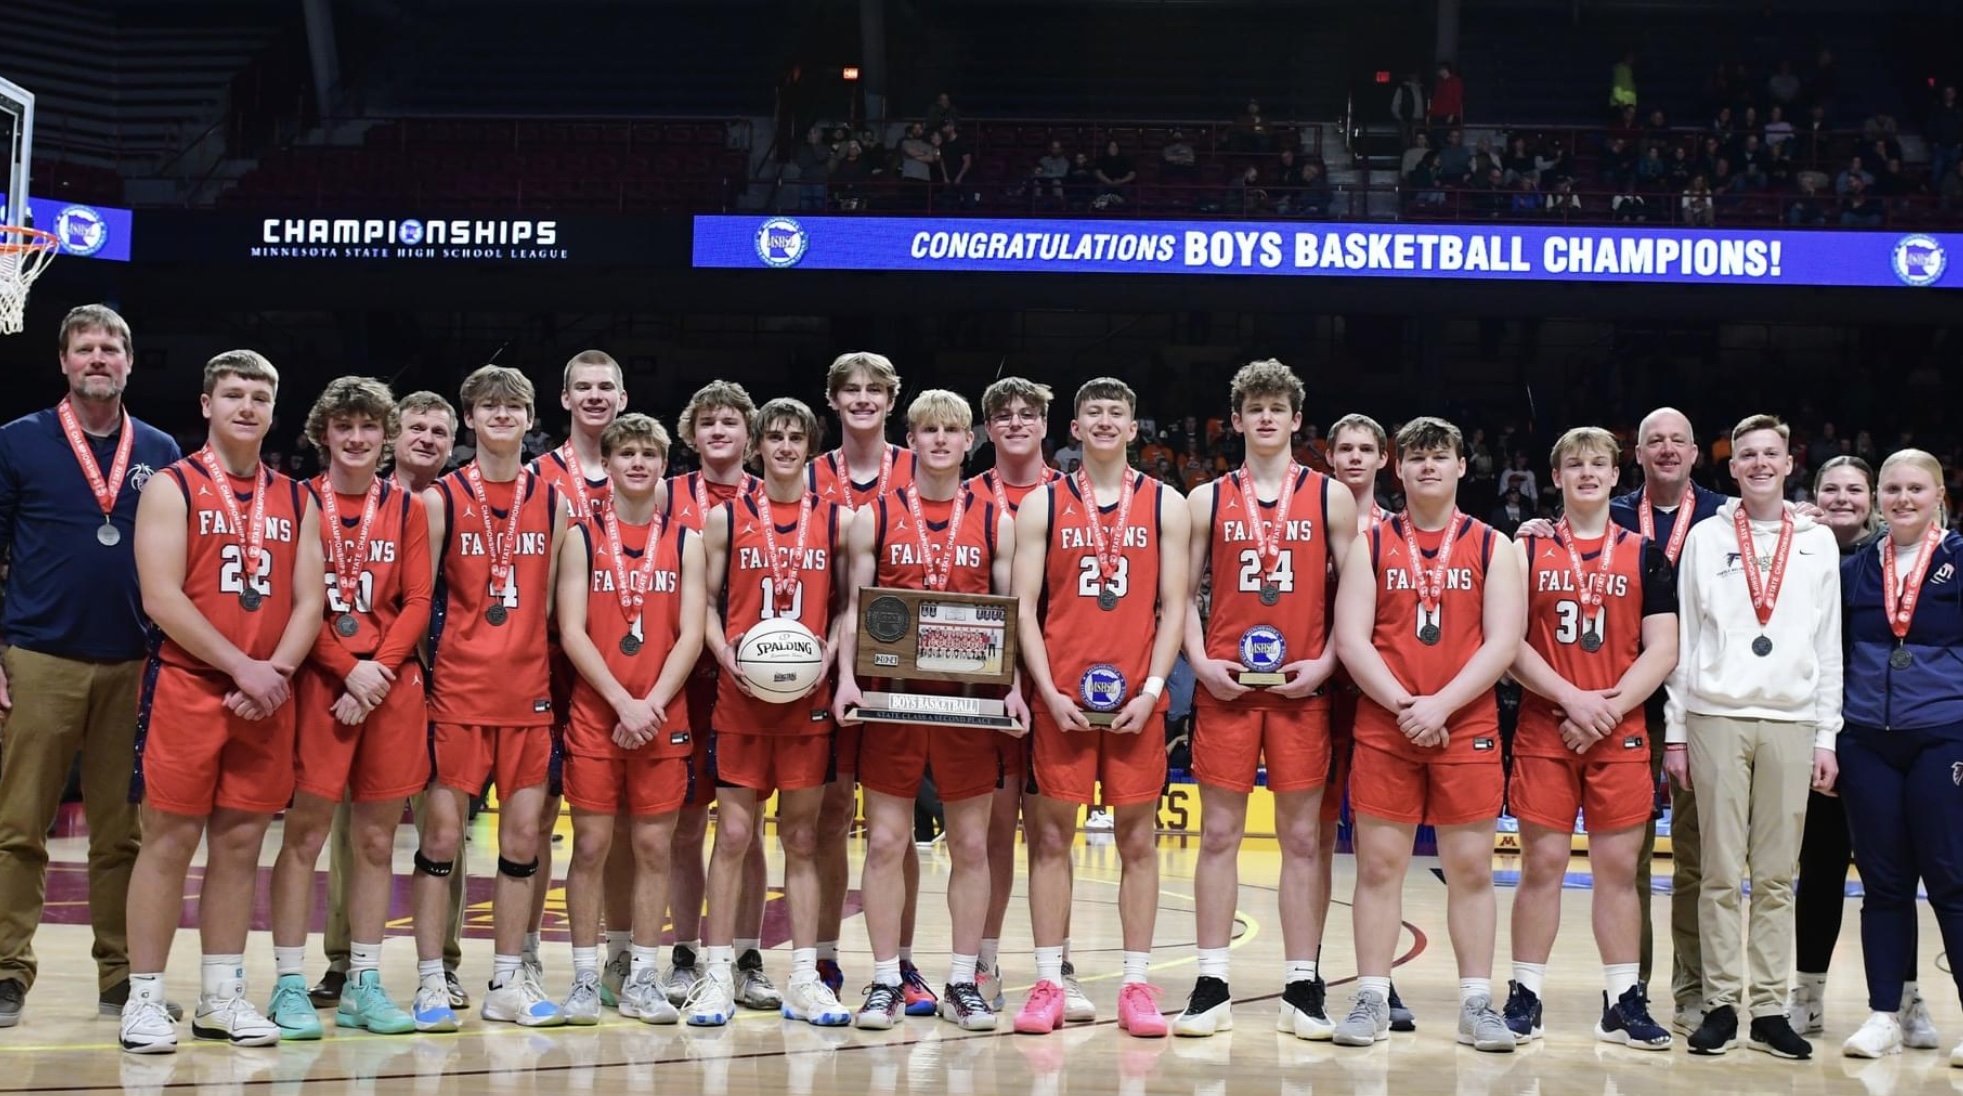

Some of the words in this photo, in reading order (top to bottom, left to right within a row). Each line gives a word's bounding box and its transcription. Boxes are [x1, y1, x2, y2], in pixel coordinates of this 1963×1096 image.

[251, 247, 337, 257] MINNESOTA
[345, 248, 388, 258] STATE
[398, 248, 435, 258] HIGH
[443, 249, 502, 258] SCHOOL
[511, 249, 568, 259] LEAGUE
[911, 231, 1175, 262] CONGRATULATIONS
[1184, 231, 1282, 268] BOYS
[1294, 232, 1531, 272] BASKETBALL
[1543, 235, 1782, 276] CHAMPIONS!
[198, 510, 292, 542] FANS
[1061, 526, 1147, 549] FALNS
[1223, 520, 1311, 542] FACNS
[461, 532, 545, 556] FACNS
[890, 544, 981, 568] FANS
[739, 547, 826, 570] FACNS
[1239, 549, 1294, 592] 24
[220, 545, 272, 597] 22
[593, 570, 677, 592] FACNS
[1078, 555, 1129, 598] 23
[1386, 568, 1472, 590] FANS
[1538, 569, 1628, 596] FALNS
[488, 564, 519, 608] 4
[1555, 599, 1607, 645] 30
[757, 641, 812, 656] SPALDING
[891, 695, 916, 707] BOYS
[918, 696, 977, 712] BASKETBALL
